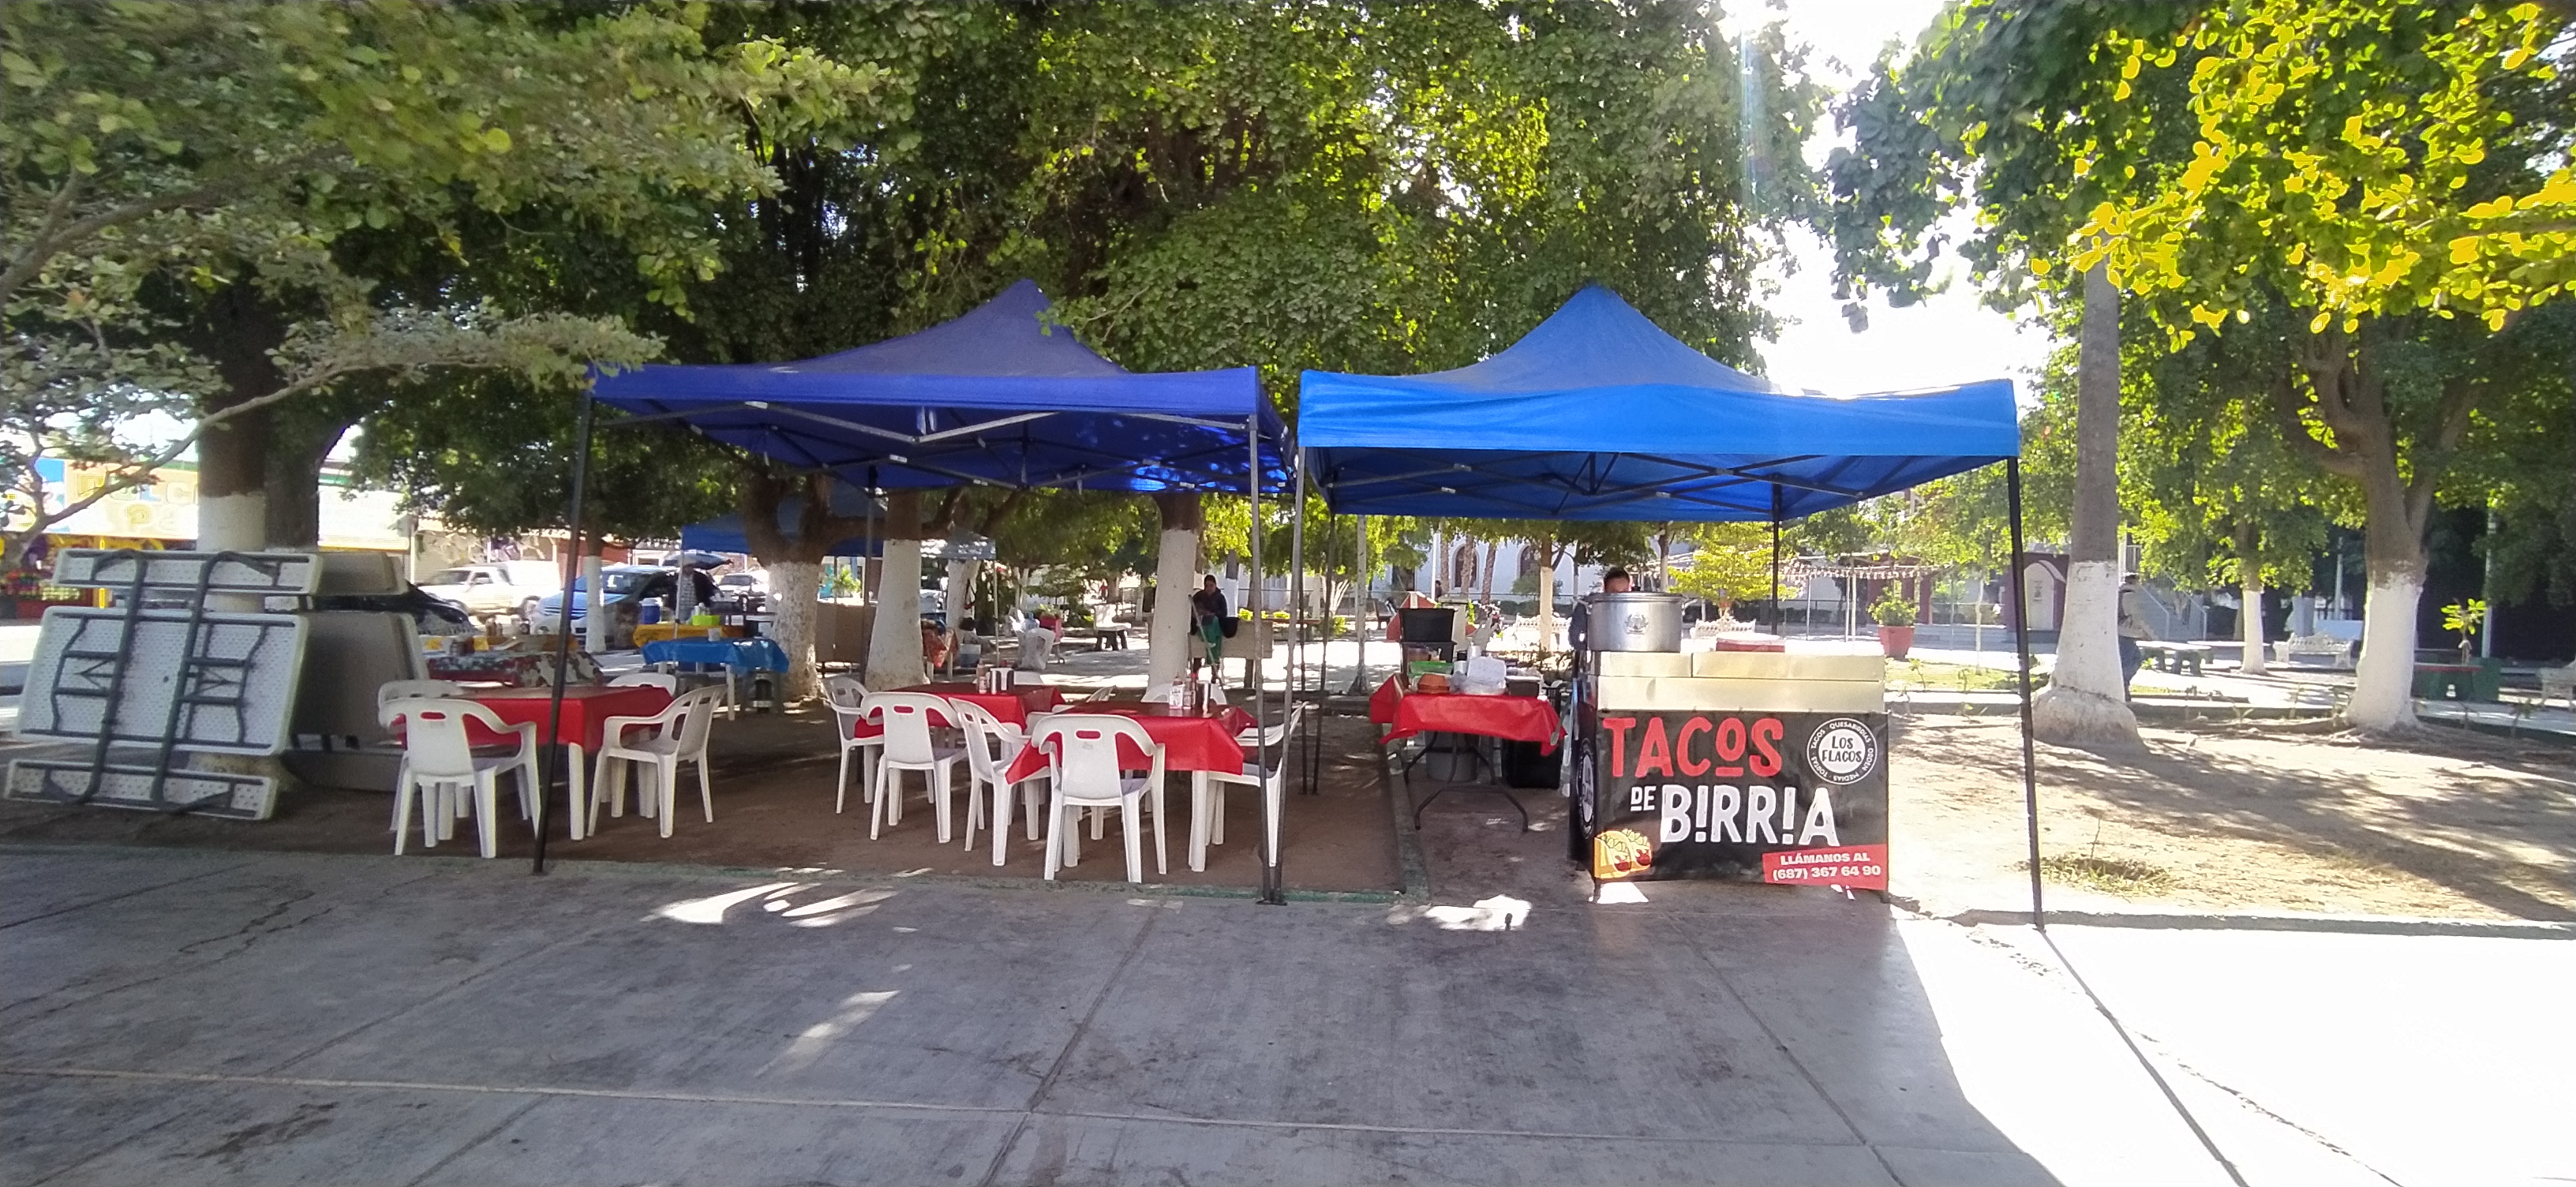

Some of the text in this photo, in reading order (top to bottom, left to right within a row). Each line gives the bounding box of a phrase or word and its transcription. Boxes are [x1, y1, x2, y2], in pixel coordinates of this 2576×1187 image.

[1603, 717, 1784, 777] TACOS
[1810, 728, 1825, 749] TACOS
[1832, 736, 1853, 749] LOS
[1822, 749, 1862, 762] FLACOS
[1810, 756, 1828, 777] TORTAS
[1833, 771, 1859, 781] MEDIAS
[1630, 786, 1657, 811] DE
[1780, 852, 1870, 866] LLÁMANOS AL
[1773, 865, 1881, 882] (687) 367 64 90
